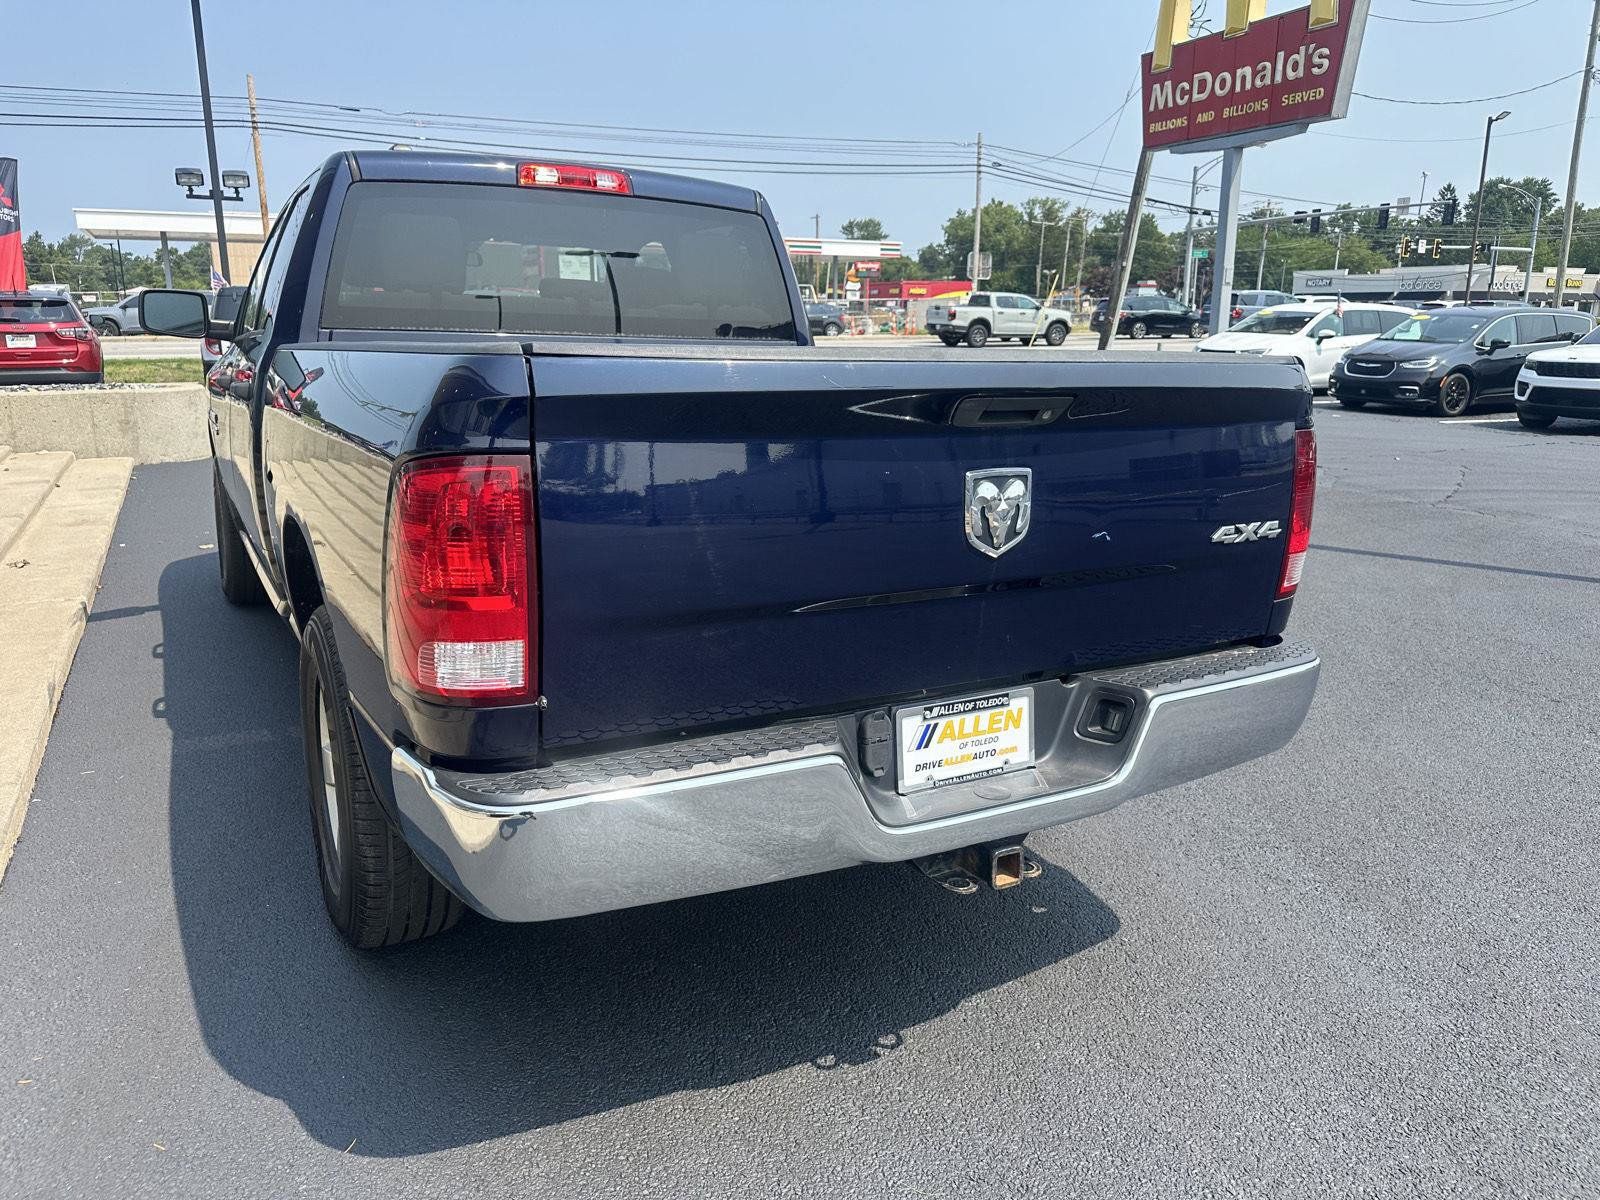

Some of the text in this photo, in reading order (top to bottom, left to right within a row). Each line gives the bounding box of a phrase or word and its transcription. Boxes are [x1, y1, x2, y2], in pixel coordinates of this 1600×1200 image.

[1149, 43, 1330, 112] McDonald's
[1149, 87, 1325, 133] BILLIONS AND BILLIONS SERVED
[1210, 520, 1282, 544] 4X4
[939, 697, 1002, 716] ALLEN OF TOLEDO
[937, 707, 1023, 744] ALLEN
[959, 736, 999, 750] OF TOLEDO
[915, 745, 1018, 772] DRIVEALLENAUTO.com
